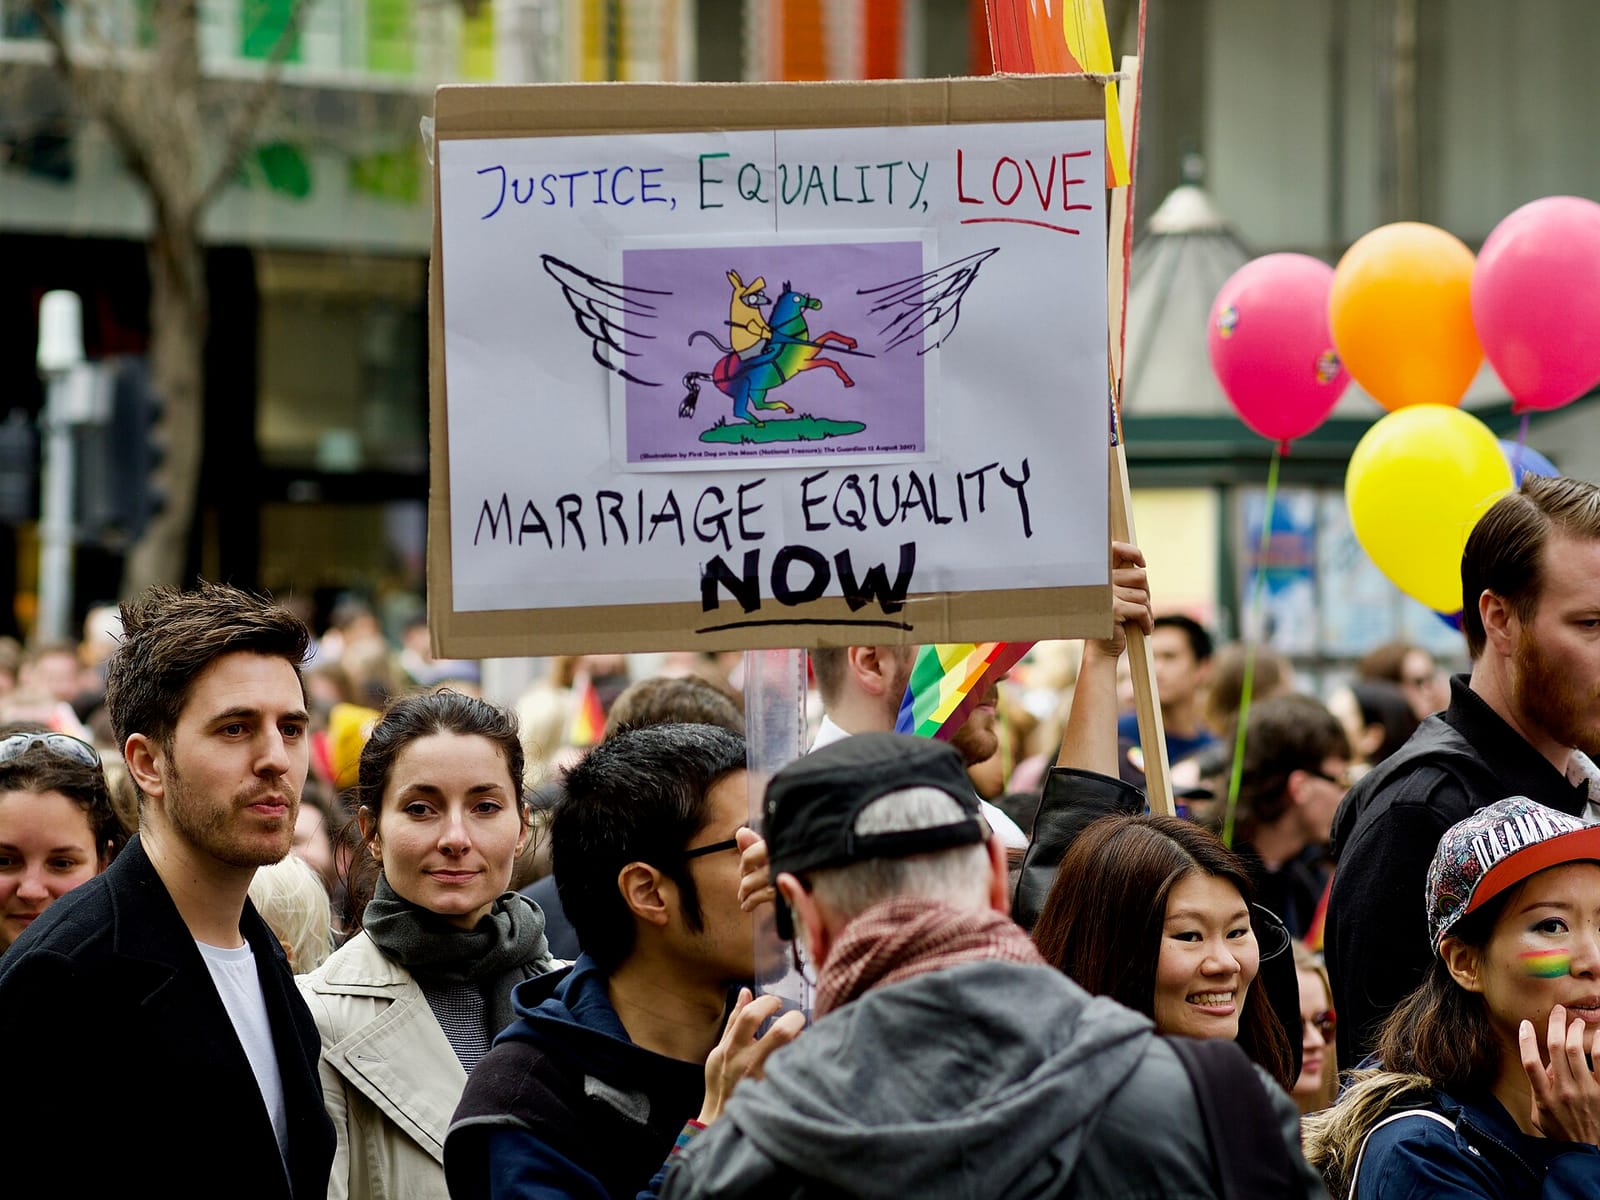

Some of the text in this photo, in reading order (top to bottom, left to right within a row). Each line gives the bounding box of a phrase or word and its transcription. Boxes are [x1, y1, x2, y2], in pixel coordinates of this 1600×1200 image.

[477, 149, 1092, 220] JUSTICE, EQUALITY, LOVE
[679, 451, 687, 459] by
[688, 450, 702, 458] First
[704, 450, 717, 459] Dog
[728, 449, 738, 457] the
[740, 448, 757, 456] Moon
[824, 446, 835, 454] The
[876, 444, 898, 452] August
[474, 457, 1033, 552] MARRIAGE EQUALITY
[700, 542, 916, 614] NOW
